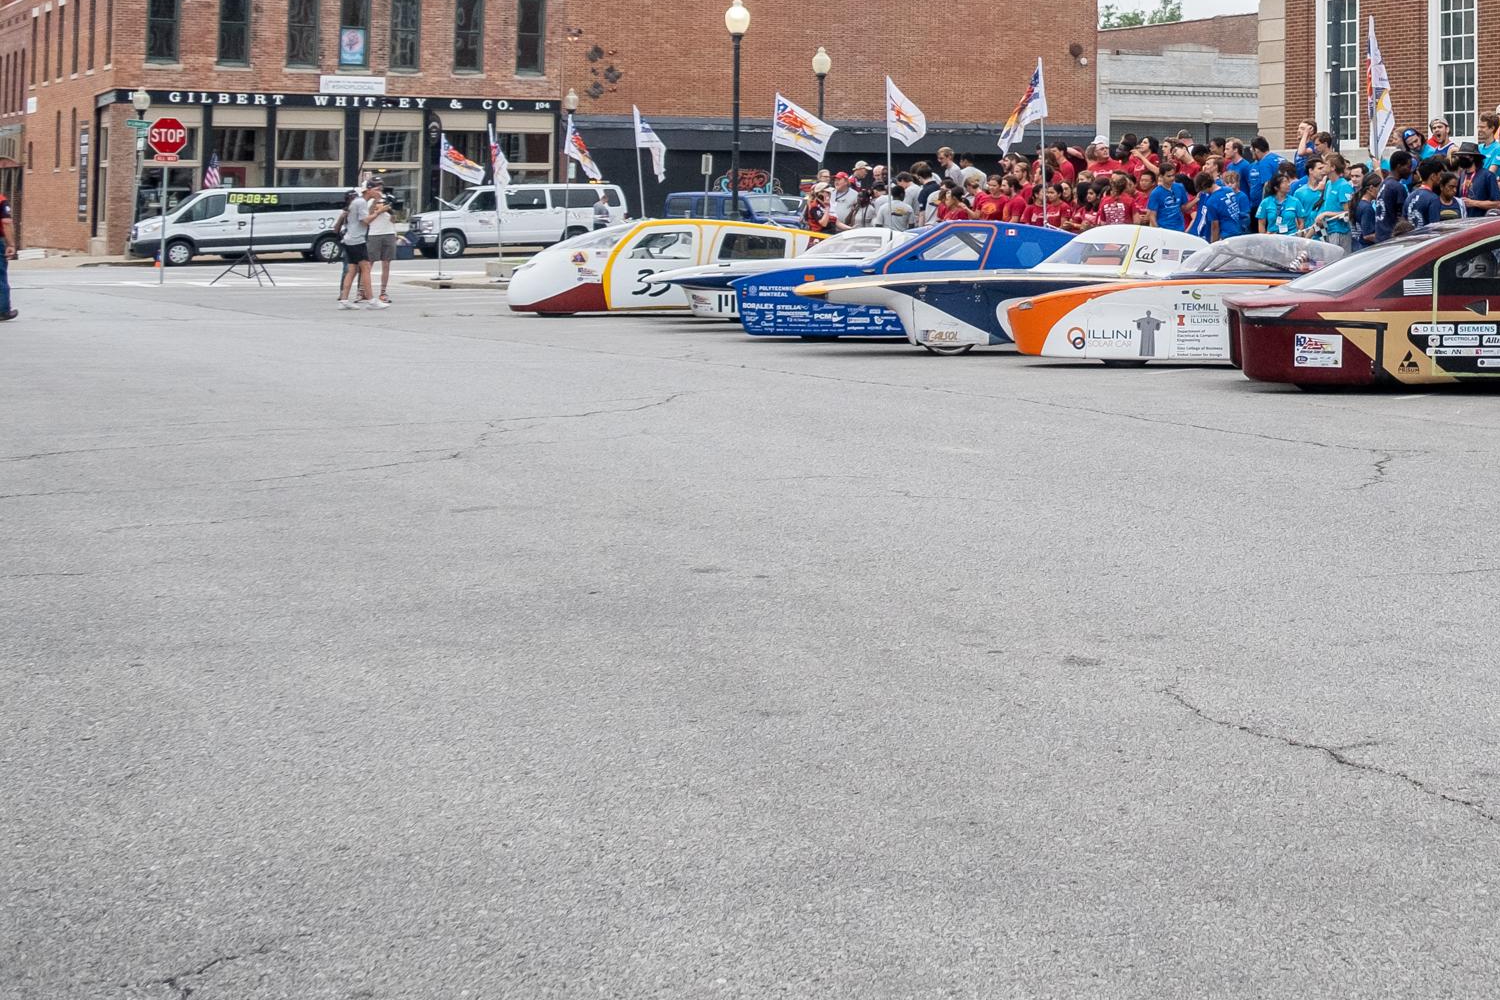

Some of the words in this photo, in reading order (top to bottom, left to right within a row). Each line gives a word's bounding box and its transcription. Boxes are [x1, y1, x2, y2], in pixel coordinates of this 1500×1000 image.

[169, 91, 285, 105] GILBERT
[449, 99, 462, 109] &
[482, 100, 514, 110] CO.
[151, 129, 185, 143] STOP
[1135, 245, 1158, 263] Cal
[1181, 303, 1219, 311] TEKMILL
[1088, 329, 1132, 339] ILLINI
[1088, 340, 1112, 348] SOLAR
[1115, 340, 1132, 348] CAR
